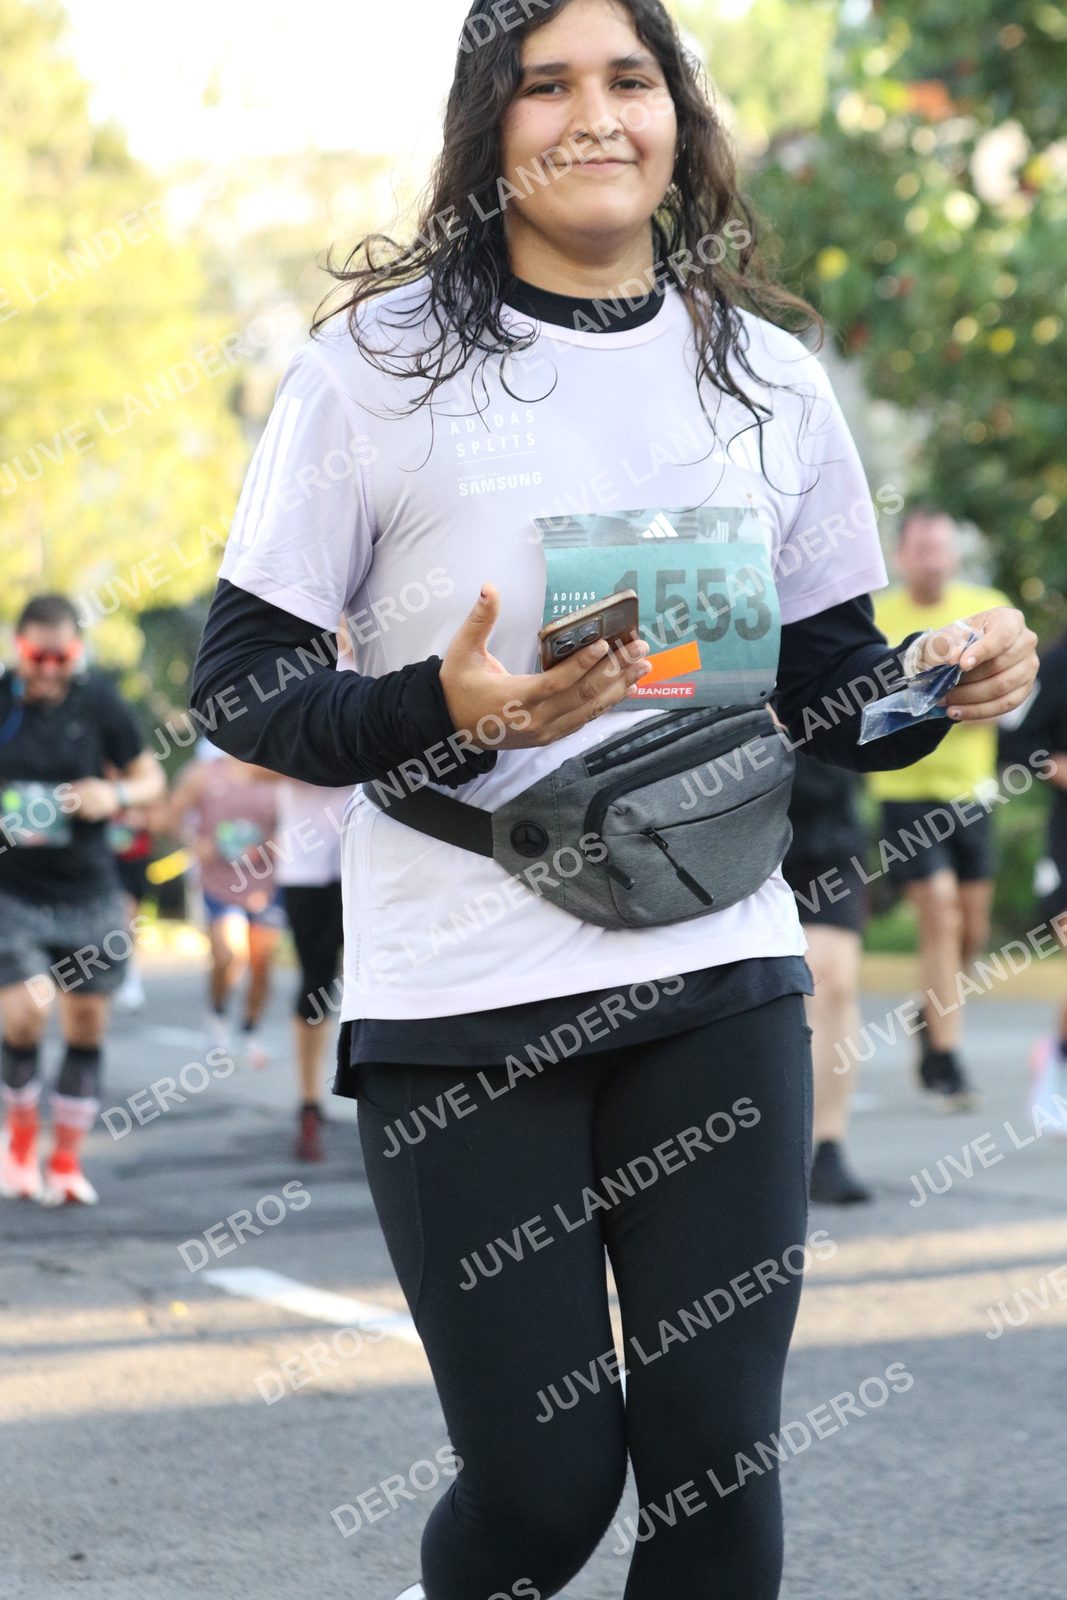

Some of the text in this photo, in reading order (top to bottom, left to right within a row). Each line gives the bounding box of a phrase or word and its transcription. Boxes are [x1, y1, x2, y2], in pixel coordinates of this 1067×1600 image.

[450, 409, 535, 436] ADIDAS
[456, 432, 536, 458] SPLITS
[458, 471, 543, 497] SAMSUNG
[552, 591, 596, 602] ADIDAS
[552, 604, 587, 614] SPLI
[637, 687, 694, 696] BANORTE
